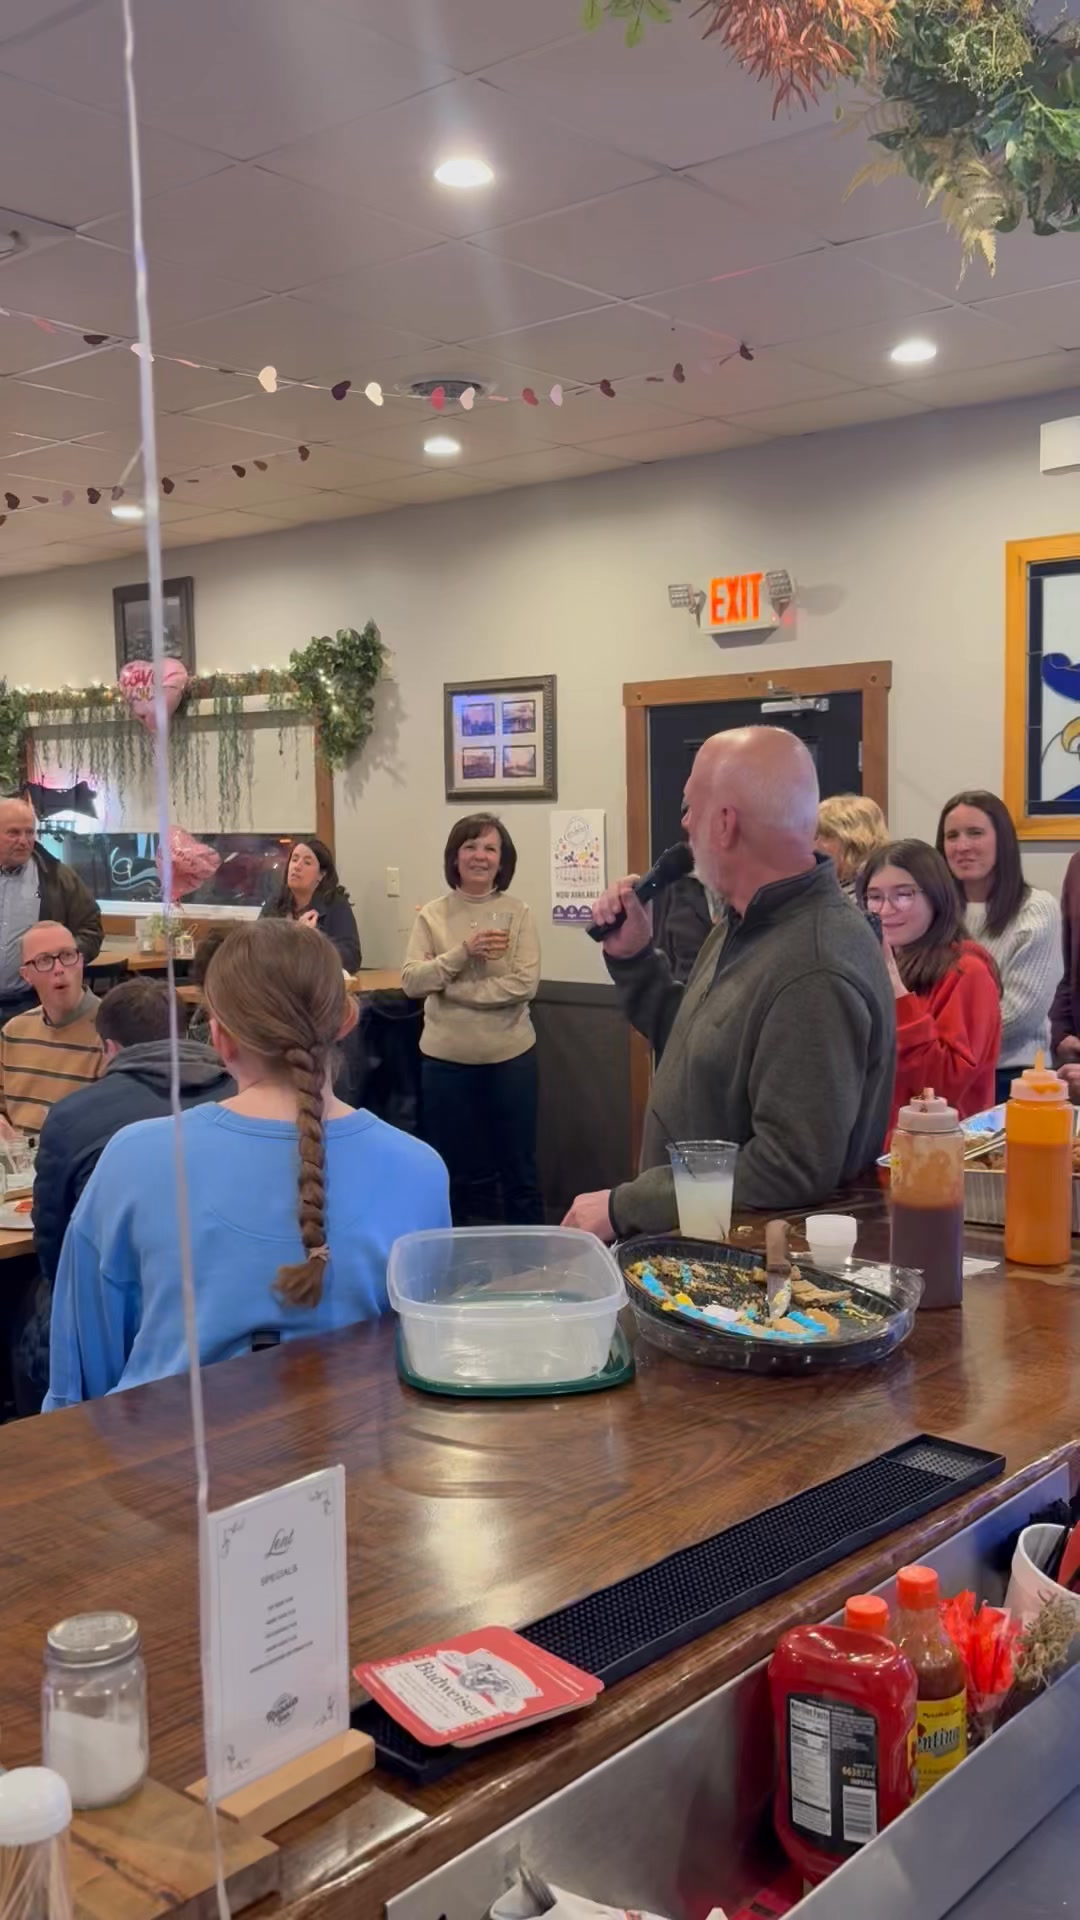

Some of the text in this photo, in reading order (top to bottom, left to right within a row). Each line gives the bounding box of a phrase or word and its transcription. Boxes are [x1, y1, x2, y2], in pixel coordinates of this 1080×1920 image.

[710, 571, 763, 625] EXIT
[556, 891, 570, 899] NOW
[414, 1662, 483, 1716] Budweiser
